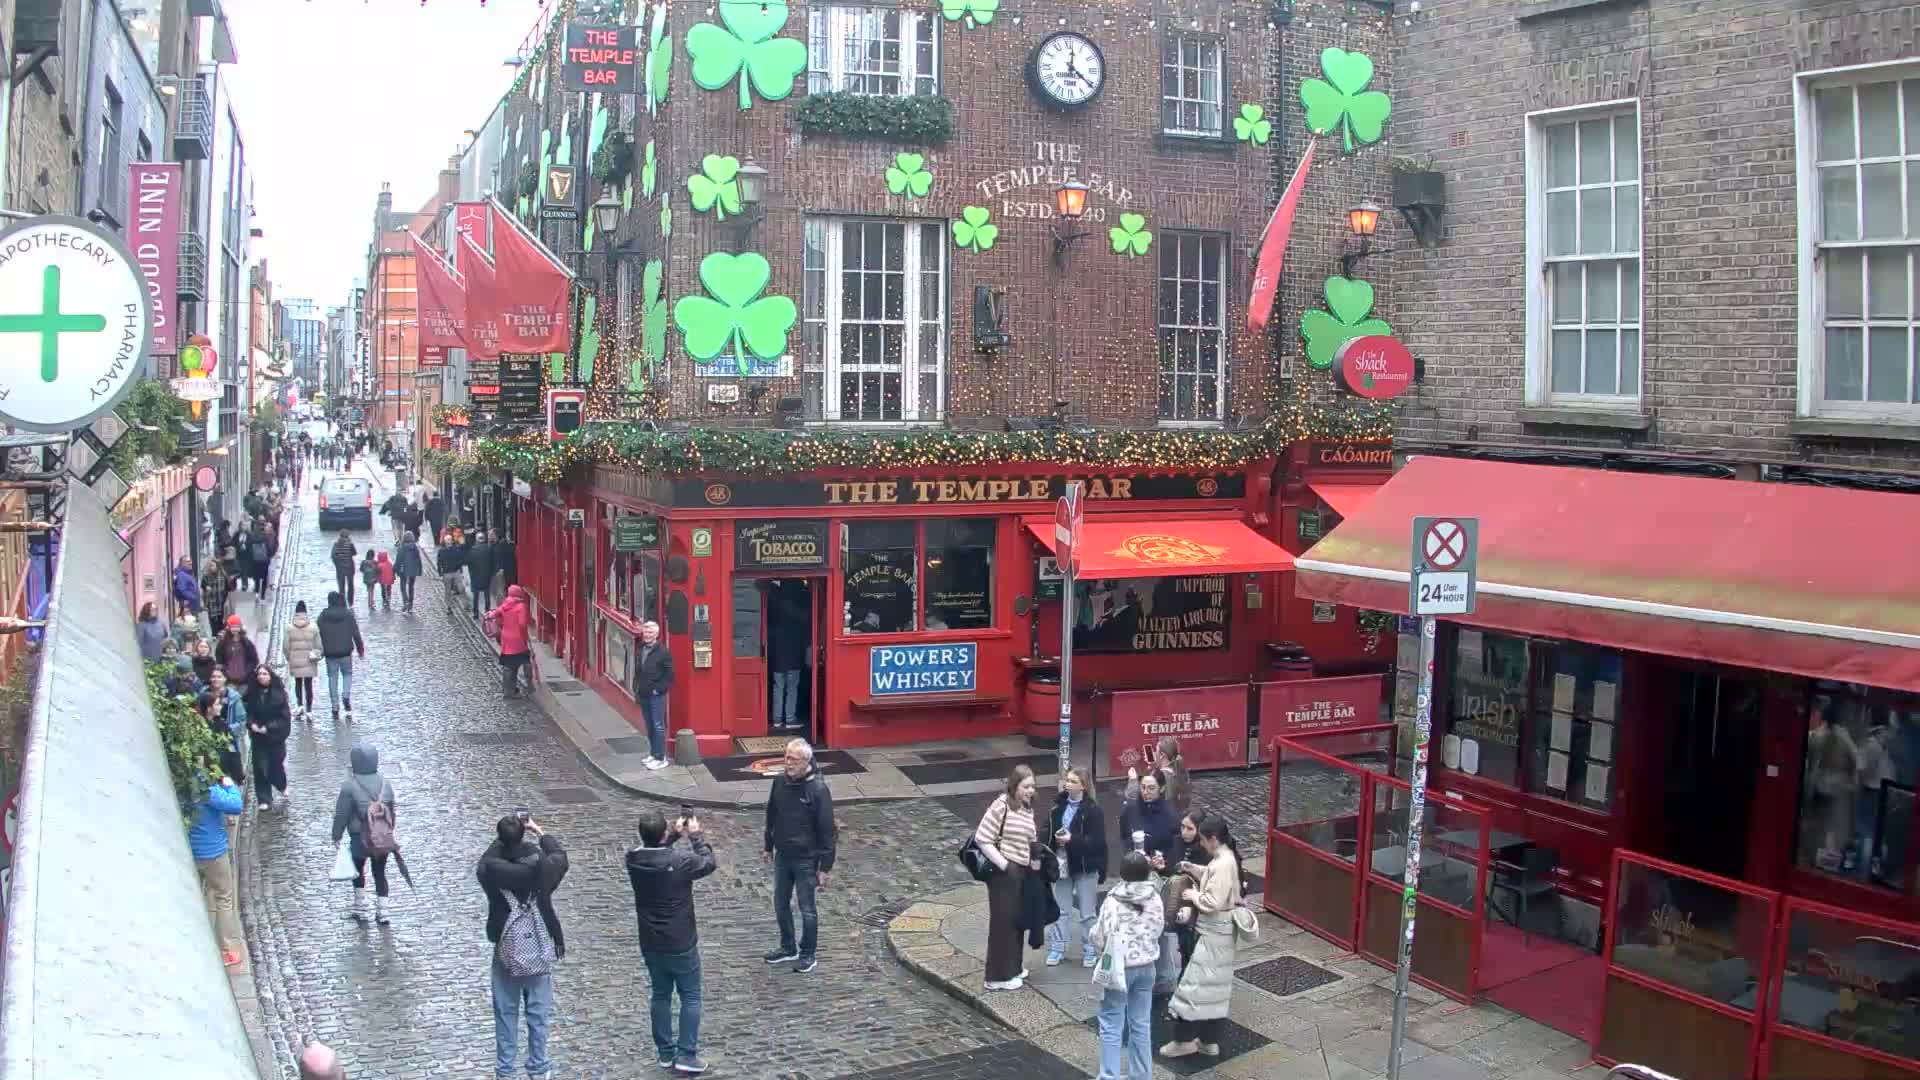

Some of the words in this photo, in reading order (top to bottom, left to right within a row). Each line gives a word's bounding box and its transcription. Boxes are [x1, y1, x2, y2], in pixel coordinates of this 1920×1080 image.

[585, 30, 617, 46] THE
[569, 48, 632, 65] TEMPLE
[584, 69, 616, 85] BAR
[1033, 141, 1081, 162] THE
[976, 165, 1077, 199] TEMPLE
[1088, 172, 1133, 209] BAR
[138, 171, 170, 233] NINE
[542, 210, 577, 218] GUINNESS
[0, 233, 115, 267] APOTHECARY
[521, 305, 546, 314] THE
[503, 313, 564, 327] TEMPLE
[518, 327, 550, 337] BAR
[89, 303, 137, 402] PHARMACY
[1355, 350, 1388, 374] Shack
[824, 481, 899, 503] THE
[912, 479, 1049, 502] TEMPLE
[751, 539, 817, 561] TOBACCO
[873, 554, 889, 562] THE
[847, 564, 891, 587] TEMPLE
[894, 567, 915, 587] BAR
[1175, 578, 1225, 593] EMPEROR
[1420, 584, 1442, 602] 24
[1211, 592, 1224, 608] OF
[1443, 594, 1465, 602] HOUR
[1133, 630, 1224, 650] GUINNESS
[880, 647, 969, 666] POWER'S
[874, 671, 973, 690] WHISKEY
[1285, 709, 1332, 723] TEMPLE
[1334, 706, 1356, 719] BAR
[1313, 702, 1332, 710] THE
[1171, 713, 1192, 722] THE
[1141, 721, 1192, 735] TEMPLE
[1194, 718, 1220, 731] BAR
